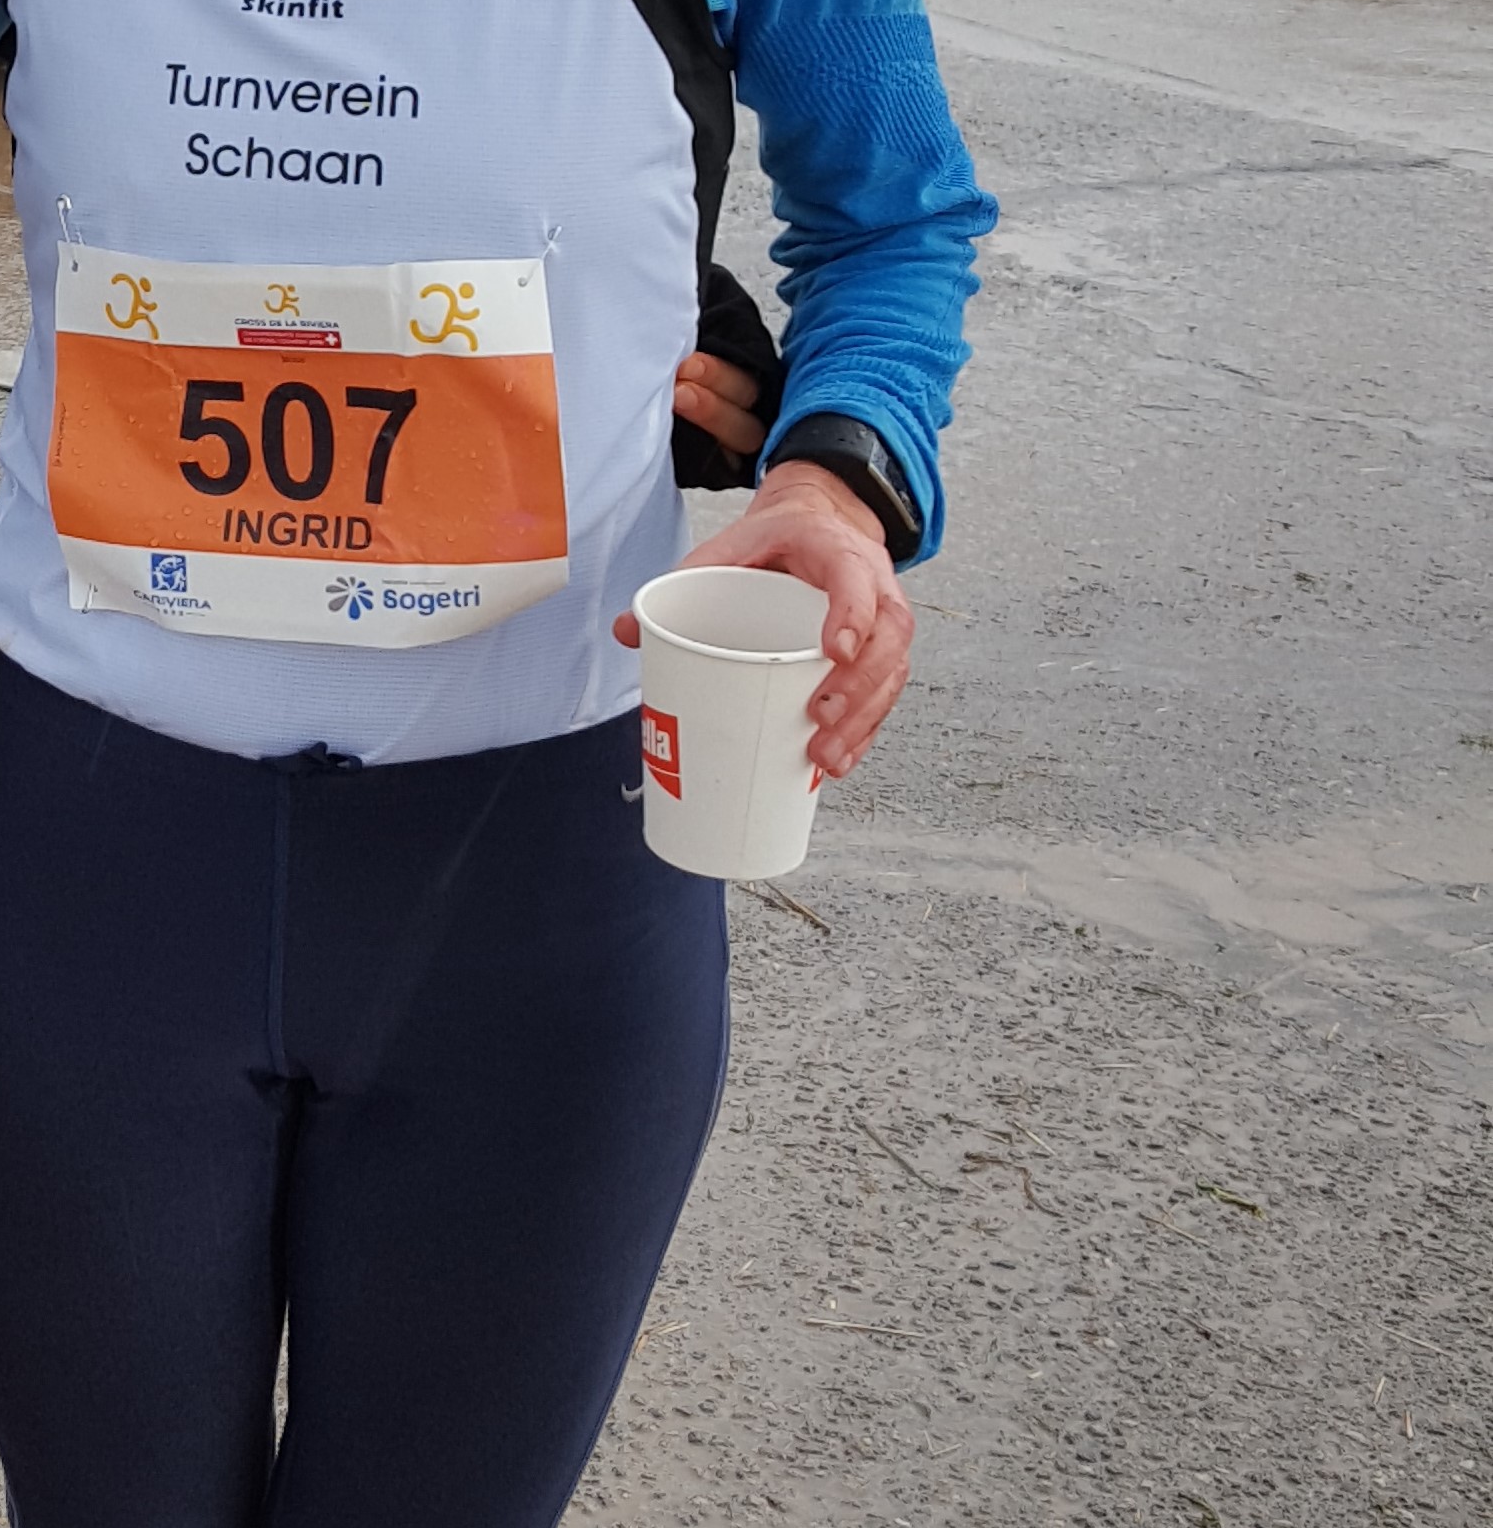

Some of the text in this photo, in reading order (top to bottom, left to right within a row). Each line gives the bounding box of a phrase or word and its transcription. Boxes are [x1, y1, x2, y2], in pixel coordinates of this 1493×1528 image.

[166, 63, 419, 119] Turnverein
[185, 132, 383, 187] Schaan
[179, 380, 417, 504] 507
[223, 509, 373, 551] INGRID
[383, 585, 480, 616] Sogetri
